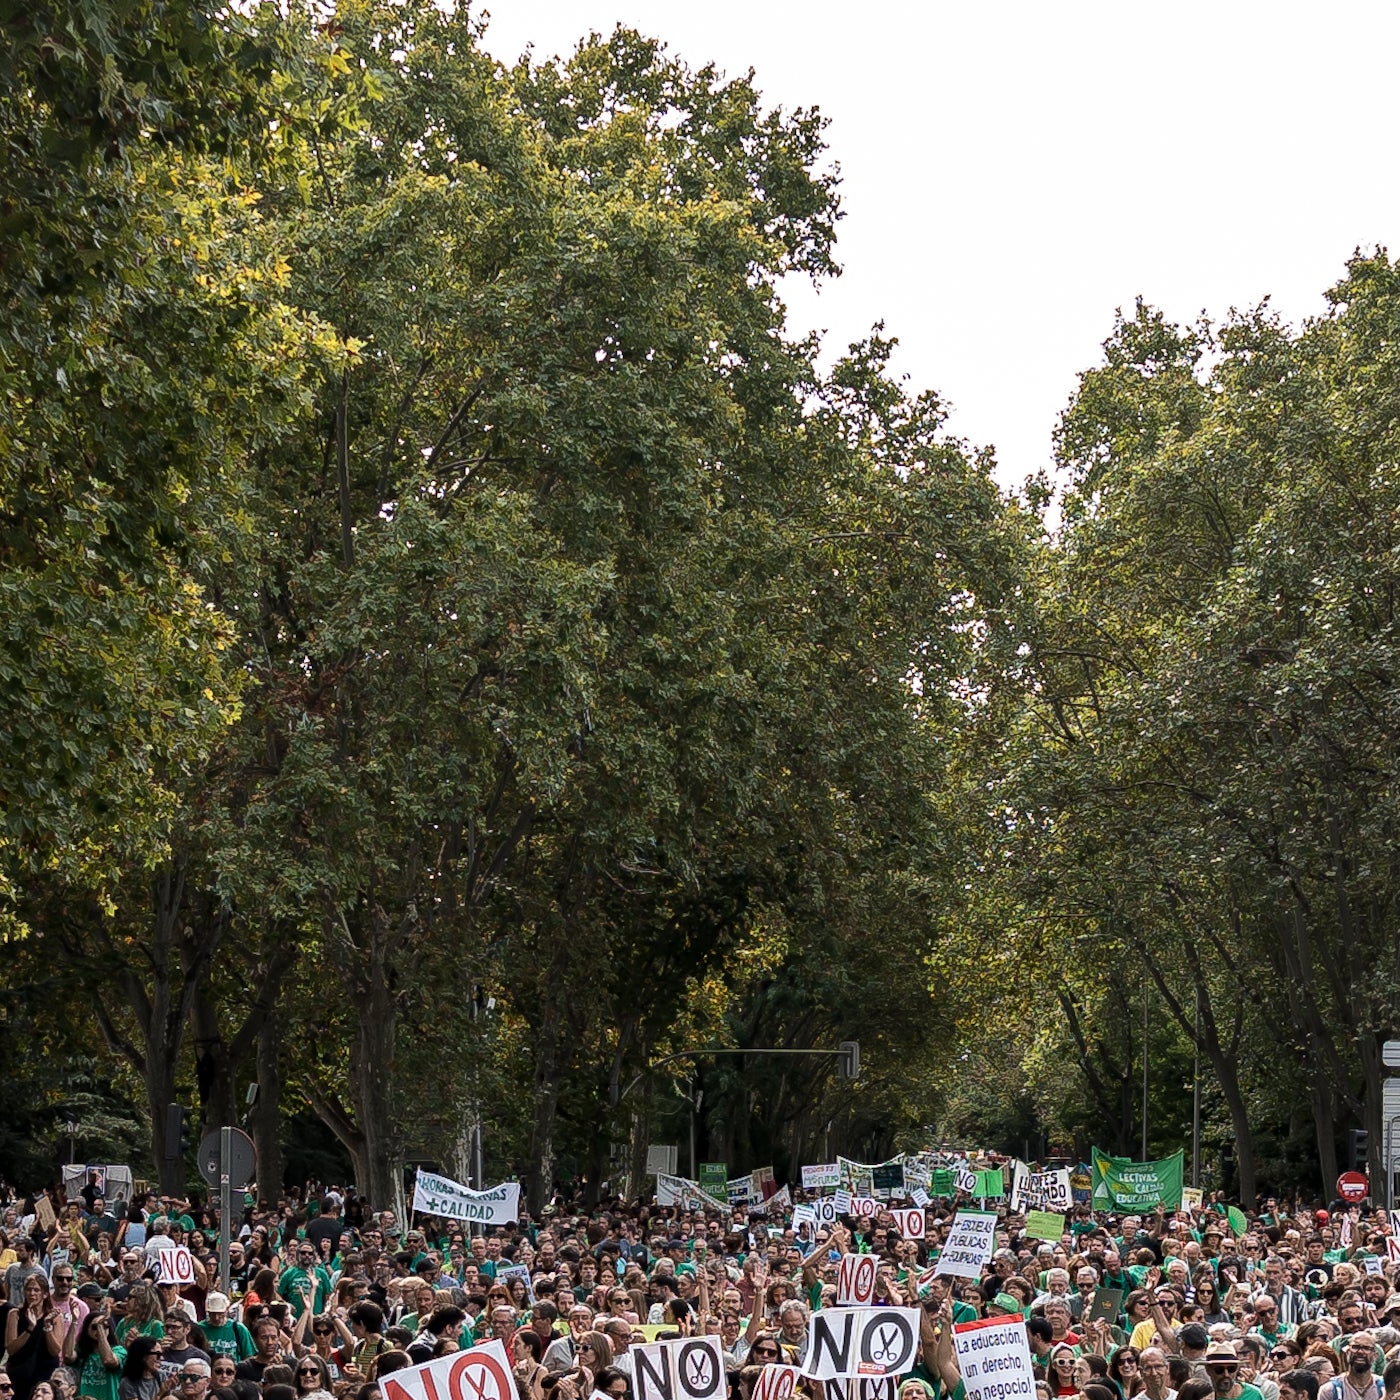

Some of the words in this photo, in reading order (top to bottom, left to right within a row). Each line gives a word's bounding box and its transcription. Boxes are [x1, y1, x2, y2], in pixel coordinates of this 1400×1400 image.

[955, 1170, 977, 1191] NO
[1120, 1173, 1157, 1182] LECTIVAS
[1117, 1193, 1159, 1204] EDUCATIVA
[960, 1219, 993, 1233] ESCUELAS
[161, 1250, 191, 1280] NO
[838, 1257, 875, 1303] NO
[808, 1311, 914, 1375] NO
[956, 1338, 970, 1354] La
[970, 1329, 1025, 1351] educación,
[965, 1364, 978, 1378] un
[982, 1355, 1025, 1375] derecho,
[983, 1377, 1033, 1400] negocio!
